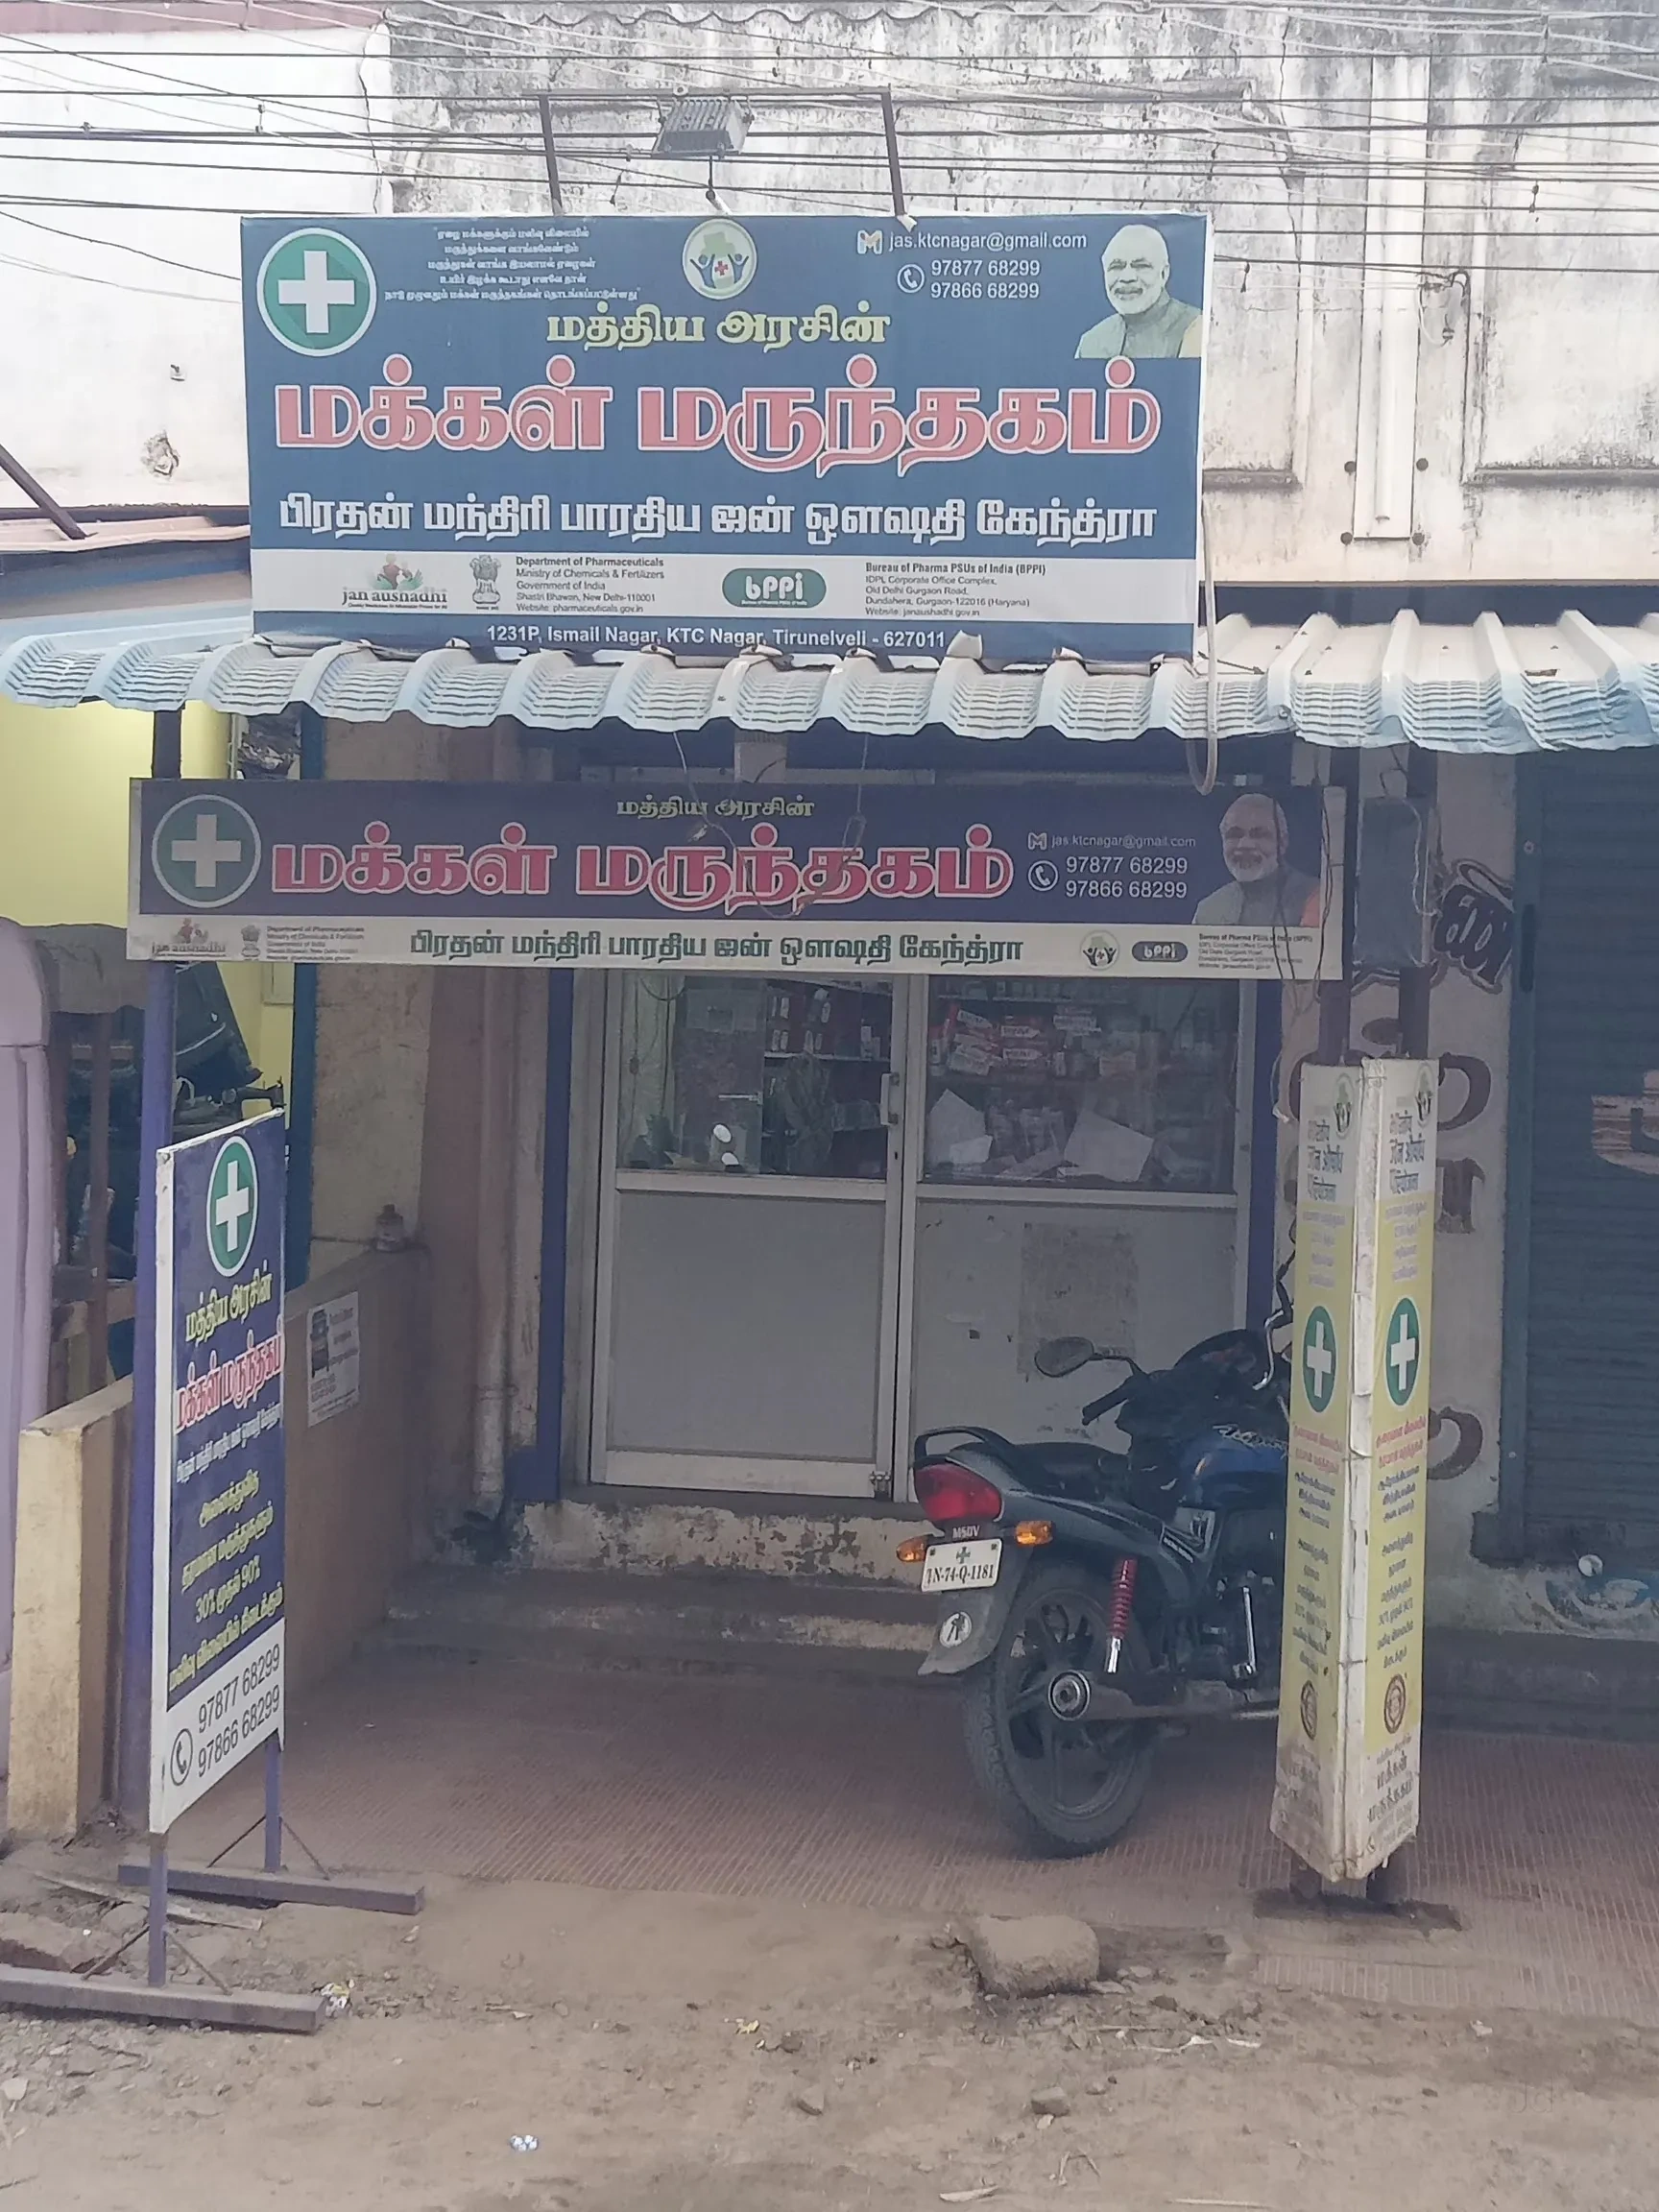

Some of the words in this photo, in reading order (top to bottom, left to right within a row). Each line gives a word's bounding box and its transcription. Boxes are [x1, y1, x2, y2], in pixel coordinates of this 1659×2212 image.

[889, 231, 1087, 252] jas.ktcnagar@gmail.com
[931, 259, 983, 276] 97877
[987, 259, 1041, 276] 68299
[931, 282, 983, 300] 97866
[987, 282, 1040, 300] 68299
[546, 301, 705, 351] மத்திய
[716, 301, 891, 353] அரசின்
[275, 353, 613, 450] மக்கள்
[637, 353, 1162, 478] மருந்தகம்
[279, 492, 413, 540] பிரதன்
[423, 493, 551, 541] மந்திரி
[561, 494, 701, 542] பாரதிய
[711, 494, 794, 534] ஜன்
[976, 496, 1157, 548] கேந்த்ரா
[516, 556, 570, 567] Department
[574, 557, 583, 566] of
[585, 557, 664, 567] Pharmaceuticals
[866, 562, 899, 573] Bureau
[901, 563, 910, 573] of
[912, 563, 949, 574] Pharma
[990, 564, 1014, 574] India
[516, 580, 570, 590] Government
[486, 626, 542, 645] 1231P,
[547, 626, 600, 642] Ismail
[666, 628, 705, 644] KTC
[772, 629, 866, 647] Tirunelveli
[882, 631, 946, 648] 627011
[616, 795, 708, 819] மத்திய
[715, 794, 815, 819] அரசின்
[271, 821, 557, 895] மக்கள்
[576, 822, 1014, 916] மருந்தகம்
[1066, 856, 1124, 875] 97877
[1129, 857, 1189, 876] 68299
[1066, 879, 1123, 899] 97866
[1128, 880, 1189, 899] 68299
[410, 928, 505, 960] பிரதன்
[512, 929, 602, 961] மந்திரி
[609, 932, 708, 962] பாரதிய
[713, 931, 773, 958] ஜன்
[900, 933, 1024, 967] கேந்த்ரா
[185, 1287, 228, 1347] மத்திய
[230, 1259, 273, 1325] அரசின்
[195, 1588, 216, 1623] 30%
[241, 1555, 260, 1589] 90%
[199, 1675, 239, 1734] 97877
[242, 1643, 280, 1696] 68299
[198, 1719, 239, 1778] 97866
[241, 1684, 280, 1740] 68299
